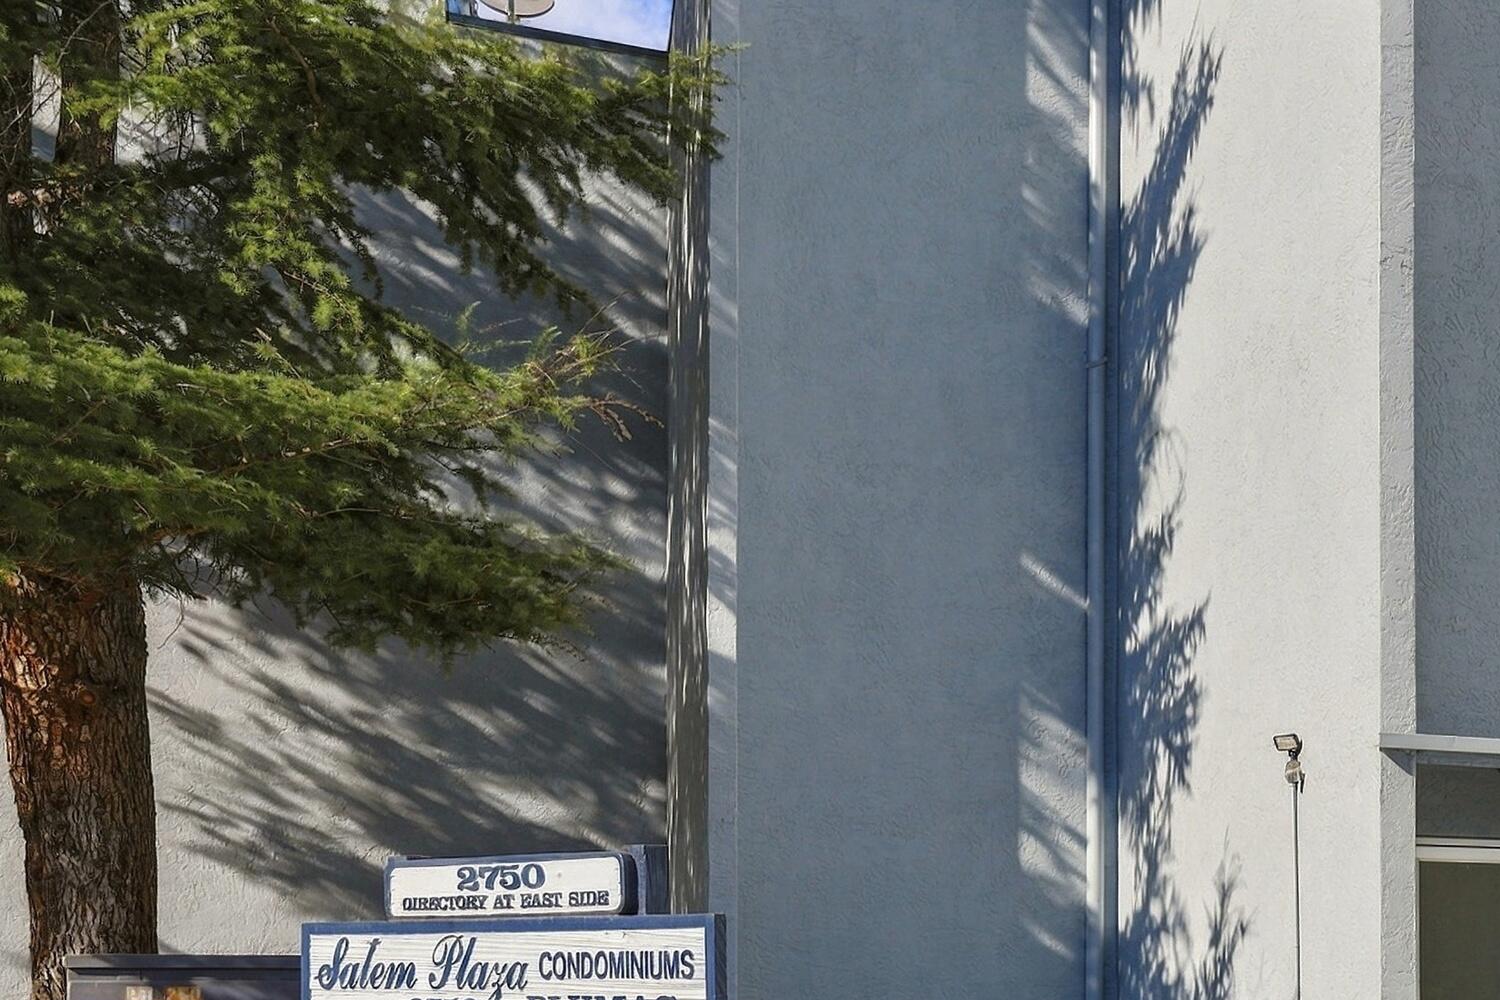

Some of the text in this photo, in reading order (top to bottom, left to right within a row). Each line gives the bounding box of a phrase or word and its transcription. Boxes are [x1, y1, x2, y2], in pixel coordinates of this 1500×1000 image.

[457, 863, 546, 891] 2750
[402, 890, 610, 911] DIRECTORY AT EAST SIDE
[315, 937, 418, 991] Salem
[538, 949, 696, 981] CONDOMINIUMS
